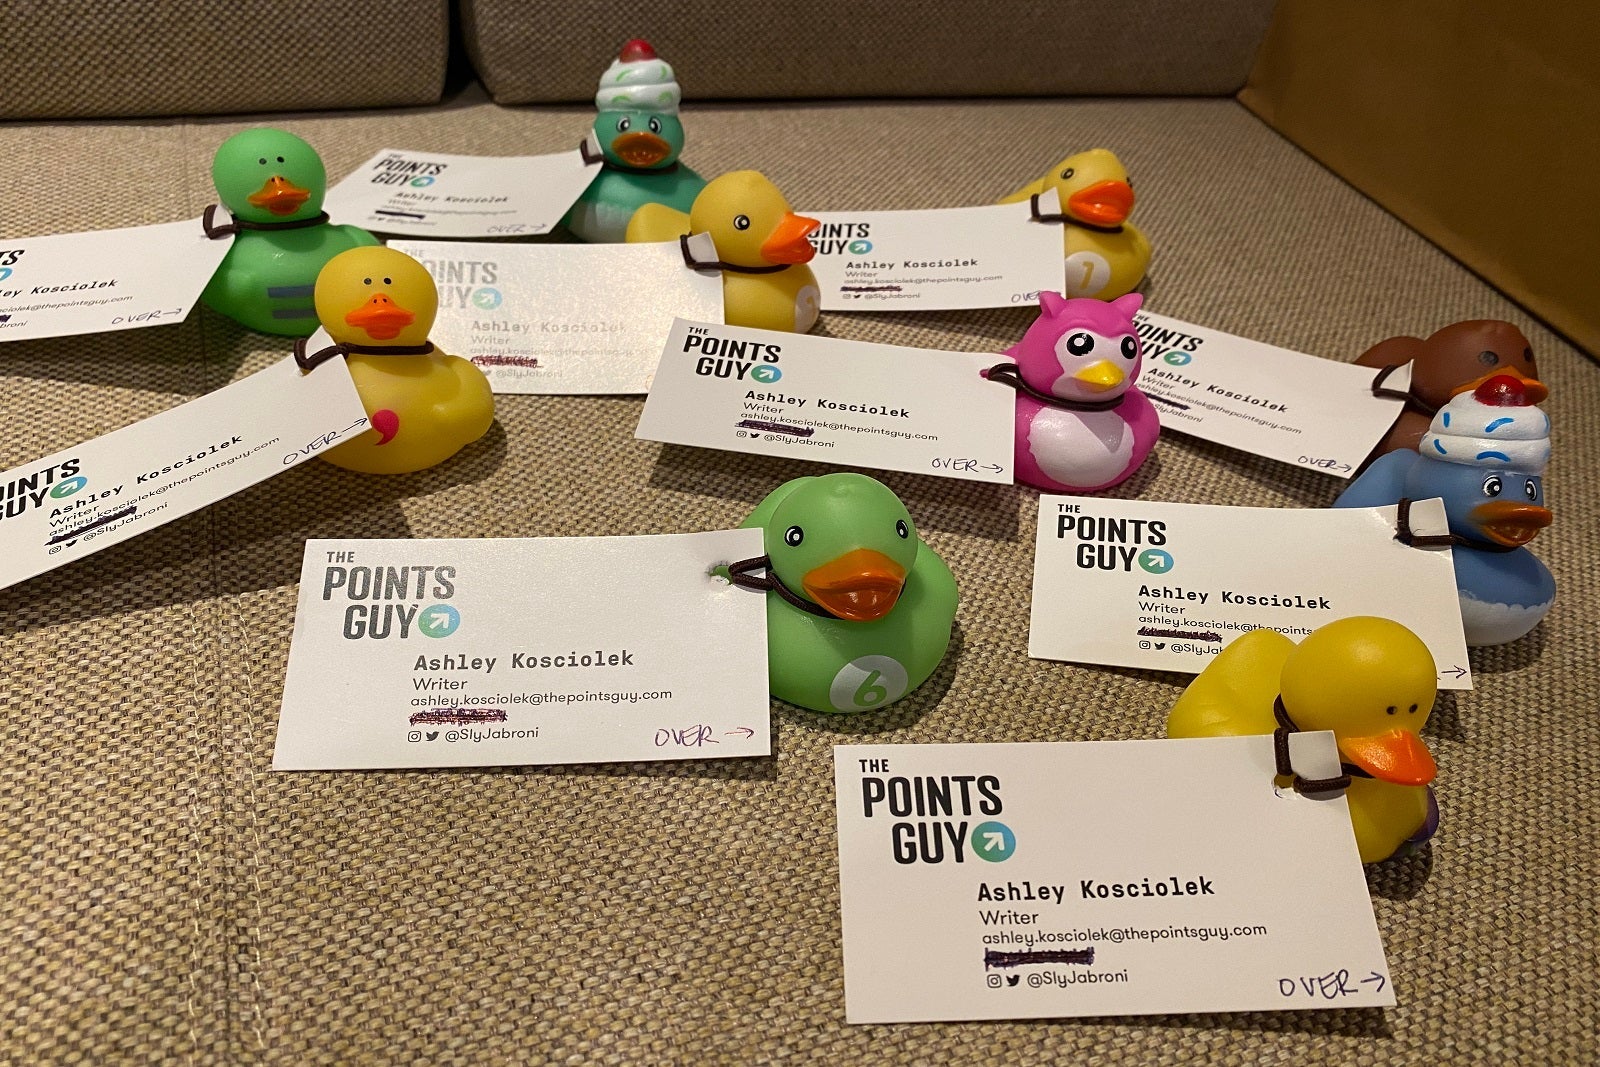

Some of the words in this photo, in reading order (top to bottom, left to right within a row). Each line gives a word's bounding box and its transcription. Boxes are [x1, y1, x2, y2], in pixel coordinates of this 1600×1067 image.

[374, 159, 448, 176] POINTS
[371, 172, 414, 186] GUY
[487, 224, 526, 233] OVER
[808, 223, 870, 238] INTS
[846, 261, 895, 271] Ashley
[903, 259, 978, 268] Kosciolek
[30, 279, 118, 295] Kosciolek
[844, 275, 1003, 285] ashley.kosciolek@thepointsguy.com
[438, 286, 472, 308] UY
[1011, 290, 1040, 303] OVE
[111, 310, 161, 325] OVER
[472, 321, 530, 335] Ashley
[688, 327, 709, 336] THE
[471, 336, 510, 345] Writer
[683, 335, 781, 363] POINTS
[695, 357, 752, 381] GUY
[1142, 376, 1175, 390] Writer
[1148, 368, 1200, 388] Ashley
[1206, 384, 1289, 413] Kosciolek
[743, 402, 784, 414] Writer
[745, 390, 807, 408] Ashley
[817, 398, 910, 419] Kosciolek
[1154, 403, 1203, 423] SlyJabroni
[740, 411, 938, 441] ashley.kosciolek@thepointsguy.com
[283, 430, 341, 466] OVER
[764, 433, 835, 448] @SlyJabroni
[931, 458, 980, 472] OVER
[1297, 456, 1338, 470] OVER
[50, 484, 124, 518] Ashley
[136, 435, 243, 485] Kosciolek
[48, 436, 280, 538] ashley.kosciolek@thepointsguy.com
[49, 505, 100, 528] Writer
[1058, 503, 1081, 514] THE
[83, 502, 169, 542] @SlyJabroni
[1057, 515, 1167, 545] POINTS
[327, 551, 355, 563] THE
[1076, 544, 1138, 572] GUY
[323, 565, 456, 601] POINTS
[1138, 585, 1209, 604] Ashley
[1221, 591, 1331, 610] Kosciolek
[1138, 601, 1186, 615] Writer
[343, 603, 418, 640] GUY
[1171, 643, 1222, 656] @SlyJa
[413, 653, 497, 674] Ashley
[512, 650, 634, 669] Kosciolek
[413, 677, 468, 691] Writer
[853, 669, 887, 706] 6
[410, 688, 672, 708] ashley.kosciolek@thepointsguy.com
[445, 727, 539, 743] @SlyJabroni
[654, 724, 719, 748] OVER
[859, 759, 889, 773] THE
[862, 775, 1003, 818] POINTS
[891, 821, 968, 865] GUY
[978, 881, 1065, 905] Ashley
[1081, 876, 1215, 900] Kosciolek
[979, 910, 1039, 926] Writer
[982, 924, 1267, 947] ashley.kosciolek@thepointsguy.com
[1027, 969, 1129, 988] @SlyJabroni
[1279, 969, 1359, 1000] OVER
